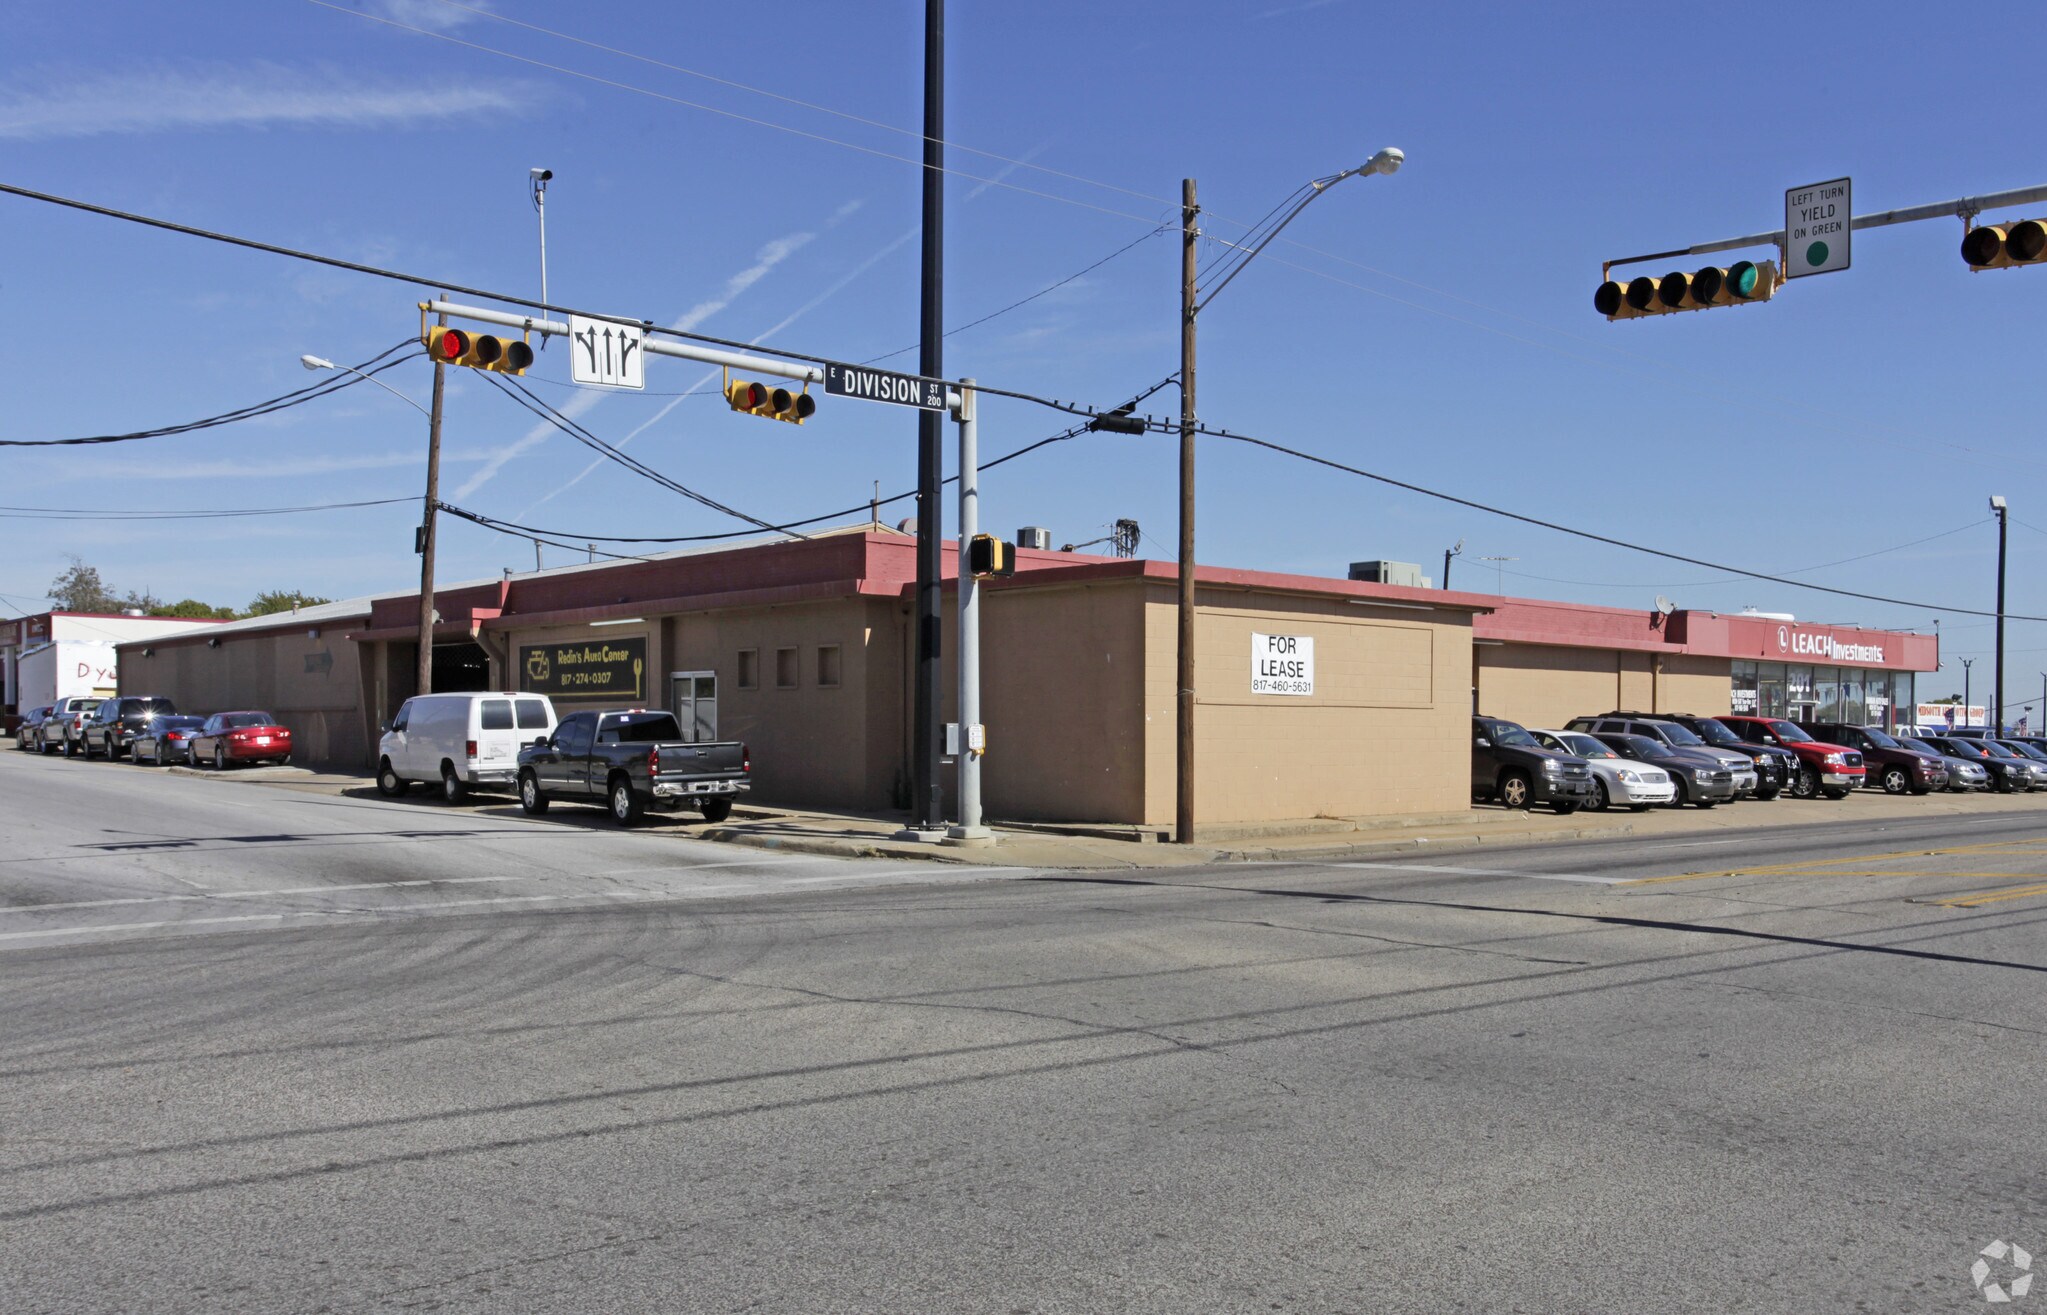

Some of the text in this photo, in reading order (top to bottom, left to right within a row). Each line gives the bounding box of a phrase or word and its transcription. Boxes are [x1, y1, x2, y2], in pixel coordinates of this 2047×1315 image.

[1792, 186, 1844, 206] LEFT TURN
[1801, 204, 1835, 222] YIELD
[1794, 221, 1842, 239] ON GREEN
[830, 367, 939, 404] E DIVISION ST
[927, 395, 942, 407] 200
[1269, 636, 1297, 654] FOR
[1792, 632, 1832, 656] LEACH
[558, 645, 629, 664] Redin's Auto Center
[1261, 659, 1304, 678] LEASE
[1253, 679, 1311, 692] 817-460-5631
[1789, 673, 1811, 692] 201
